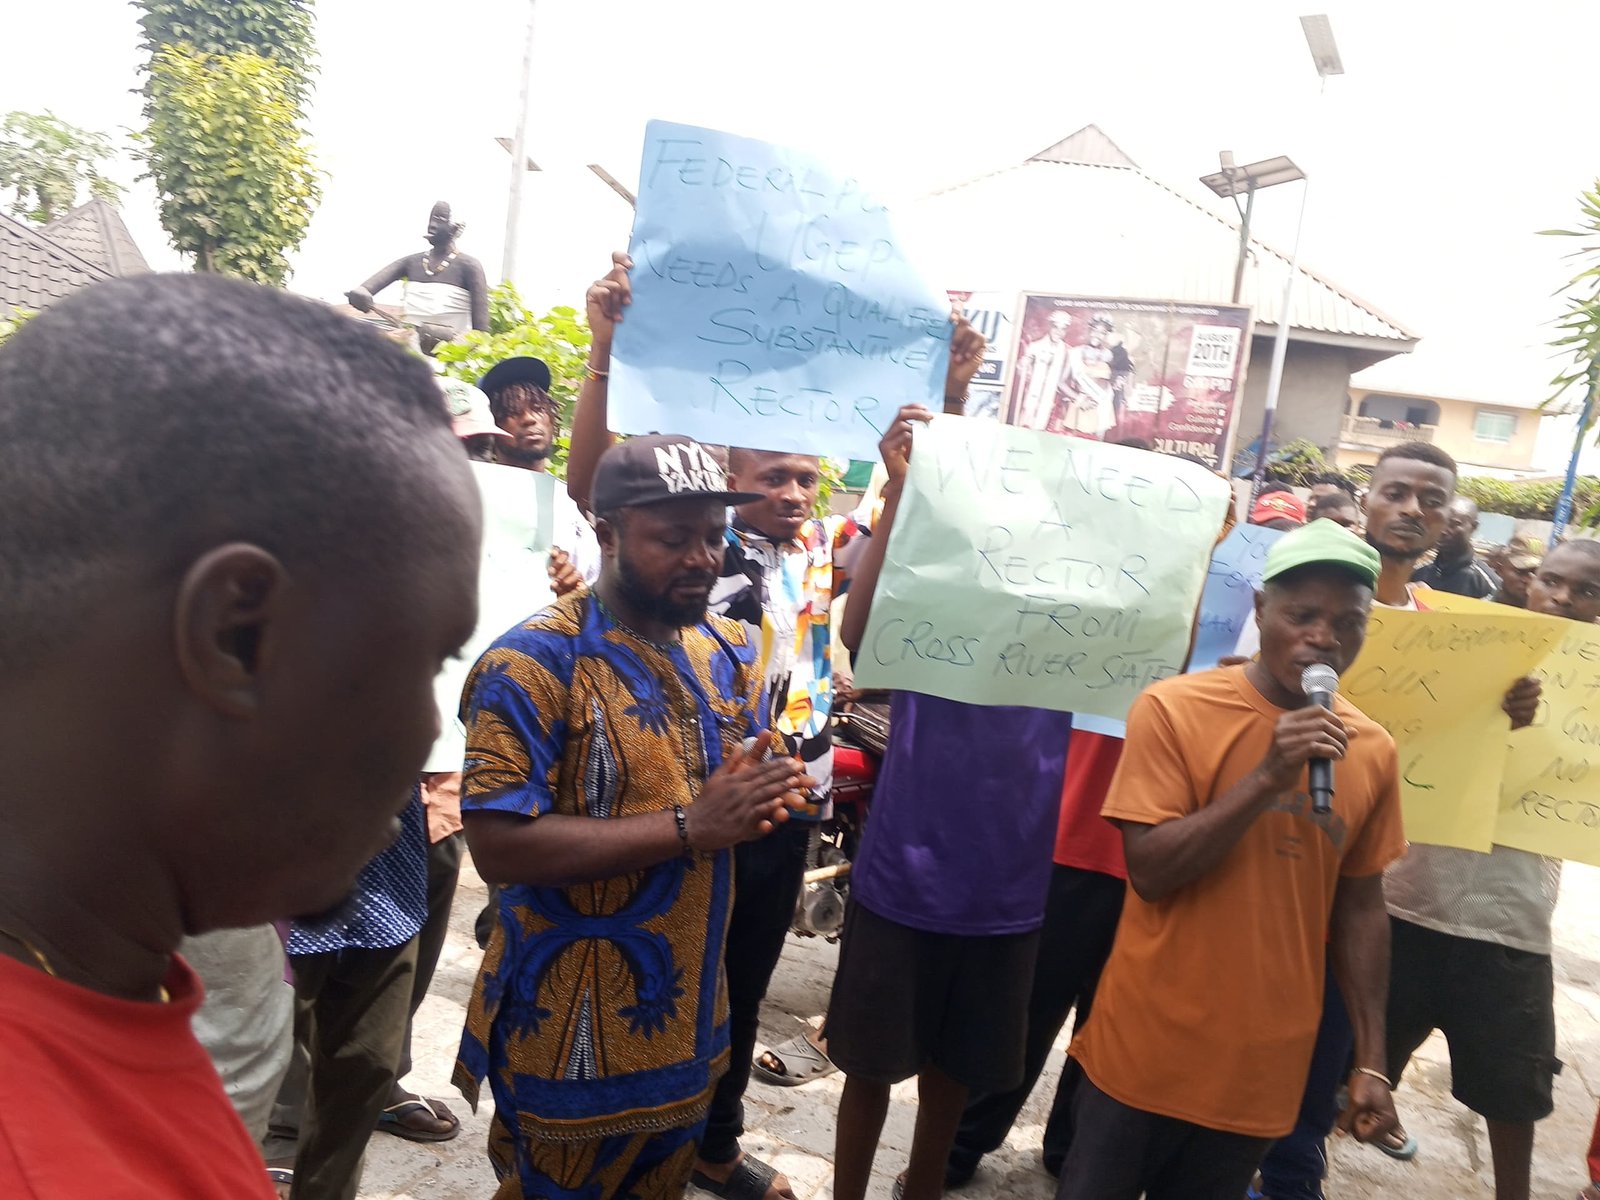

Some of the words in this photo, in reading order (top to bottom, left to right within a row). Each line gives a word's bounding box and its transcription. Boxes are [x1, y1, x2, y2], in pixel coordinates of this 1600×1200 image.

[647, 138, 826, 198] FEDERAL
[640, 239, 754, 295] NEEDS
[768, 284, 805, 316] A
[1192, 343, 1233, 362] 20TH
[709, 359, 885, 438] RECTOR
[935, 440, 1033, 496] WE
[1056, 448, 1203, 513] NEED
[1031, 500, 1074, 542] A
[974, 525, 1151, 597] RECTOR
[872, 617, 981, 668] CROSS
[992, 642, 1088, 680] RIVER
[1016, 593, 1142, 643] FROM
